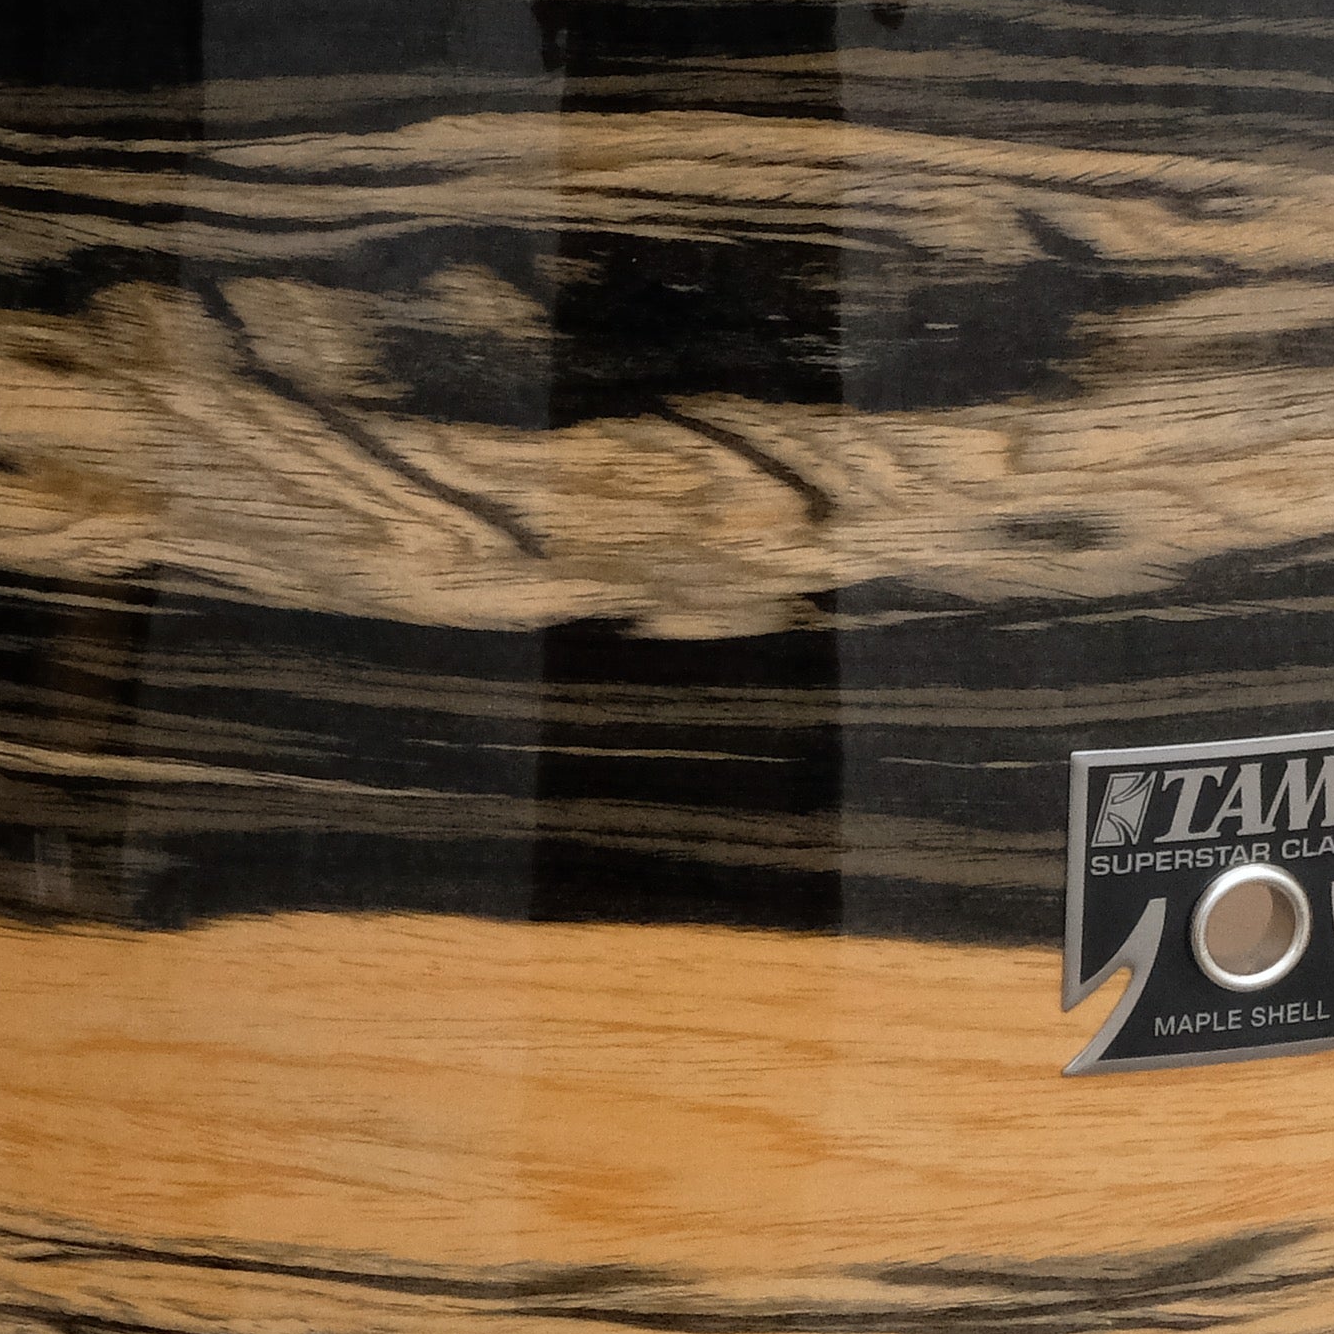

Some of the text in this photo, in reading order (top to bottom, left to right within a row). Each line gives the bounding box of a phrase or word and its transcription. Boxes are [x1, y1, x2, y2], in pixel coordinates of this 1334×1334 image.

[1089, 842, 1271, 877] SUPERSTAR
[1154, 999, 1331, 1037] MAPLE SHELL
